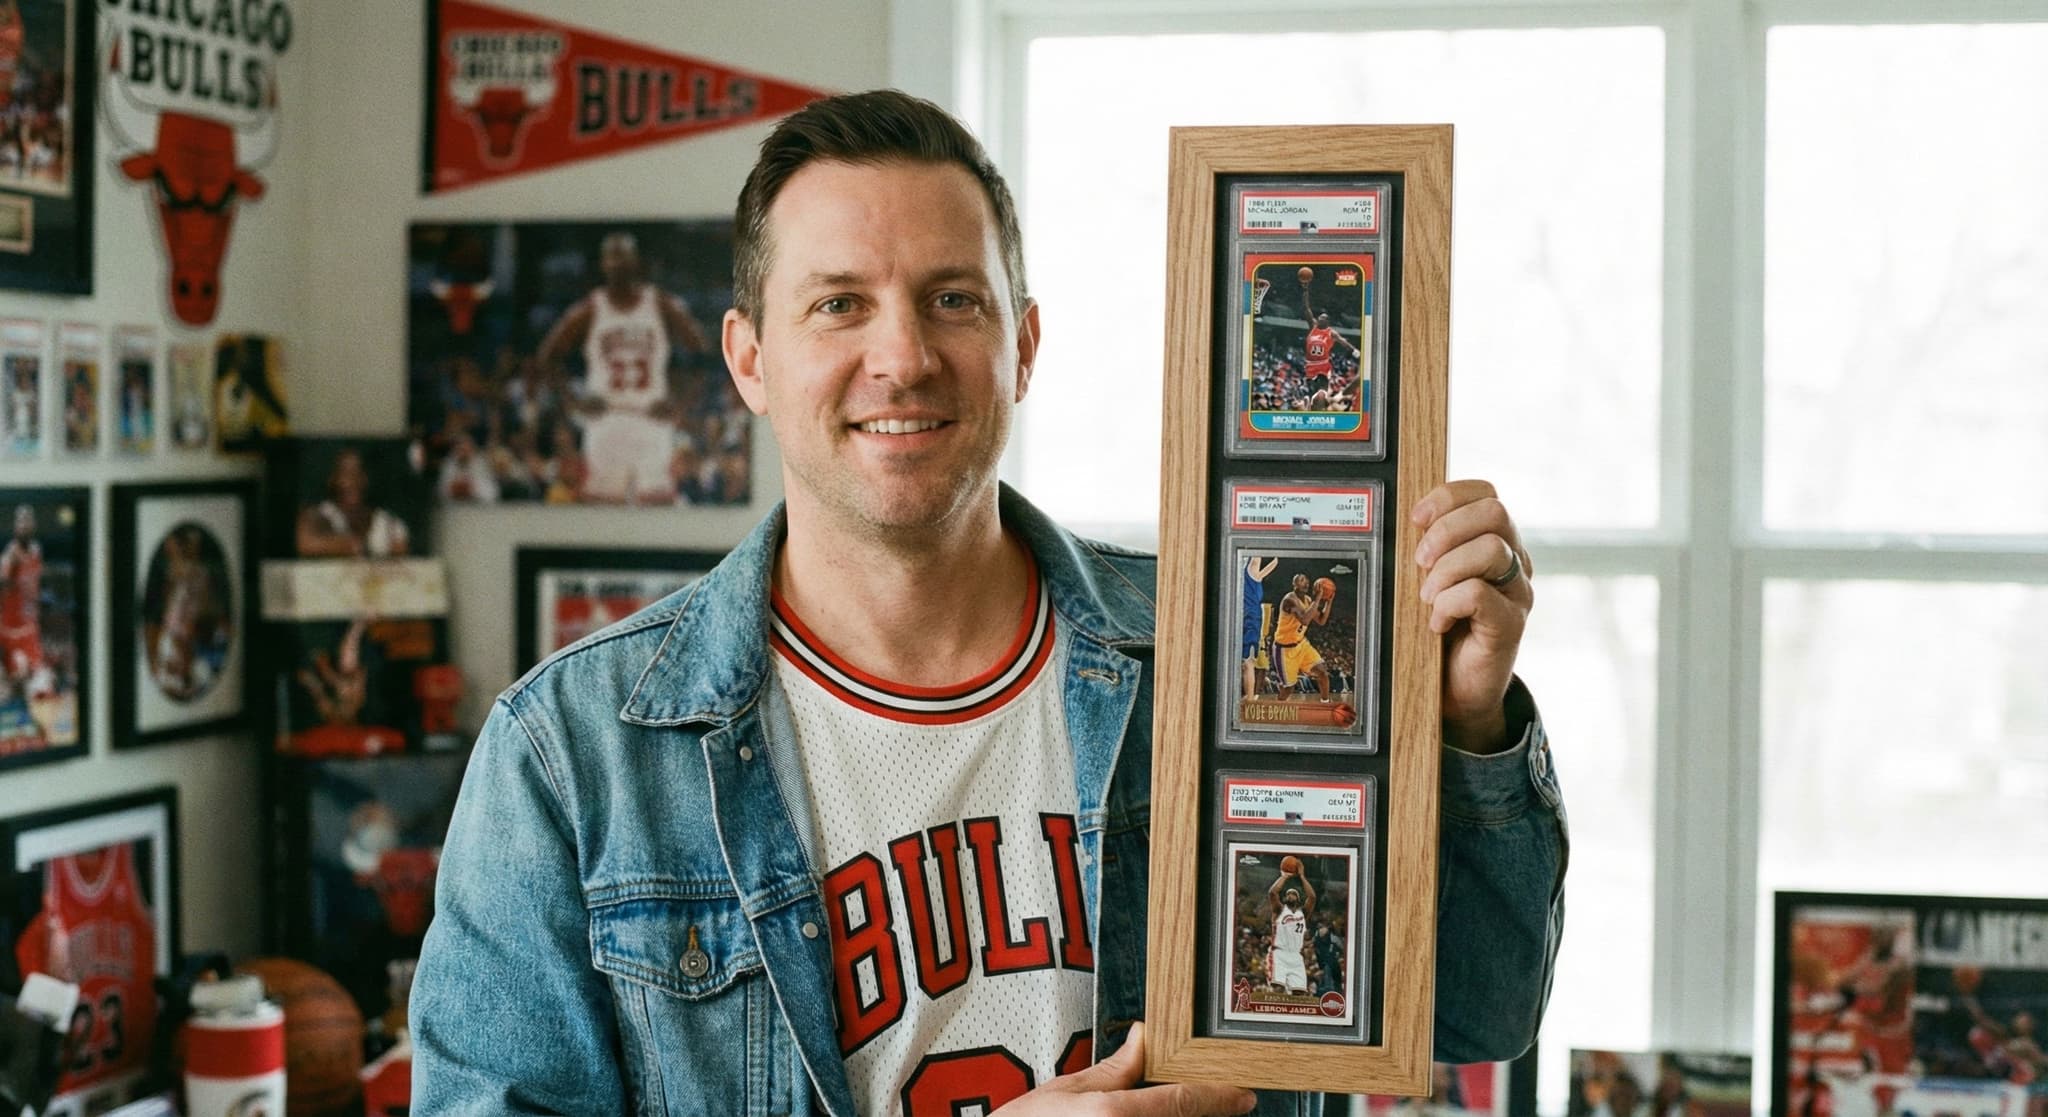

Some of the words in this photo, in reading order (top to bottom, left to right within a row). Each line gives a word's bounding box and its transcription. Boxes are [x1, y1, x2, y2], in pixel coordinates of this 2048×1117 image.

[104, 0, 293, 54] CAGO
[130, 27, 263, 109] BULLS
[577, 62, 757, 135] BULLS
[1255, 1005, 1287, 1013] LEBRON
